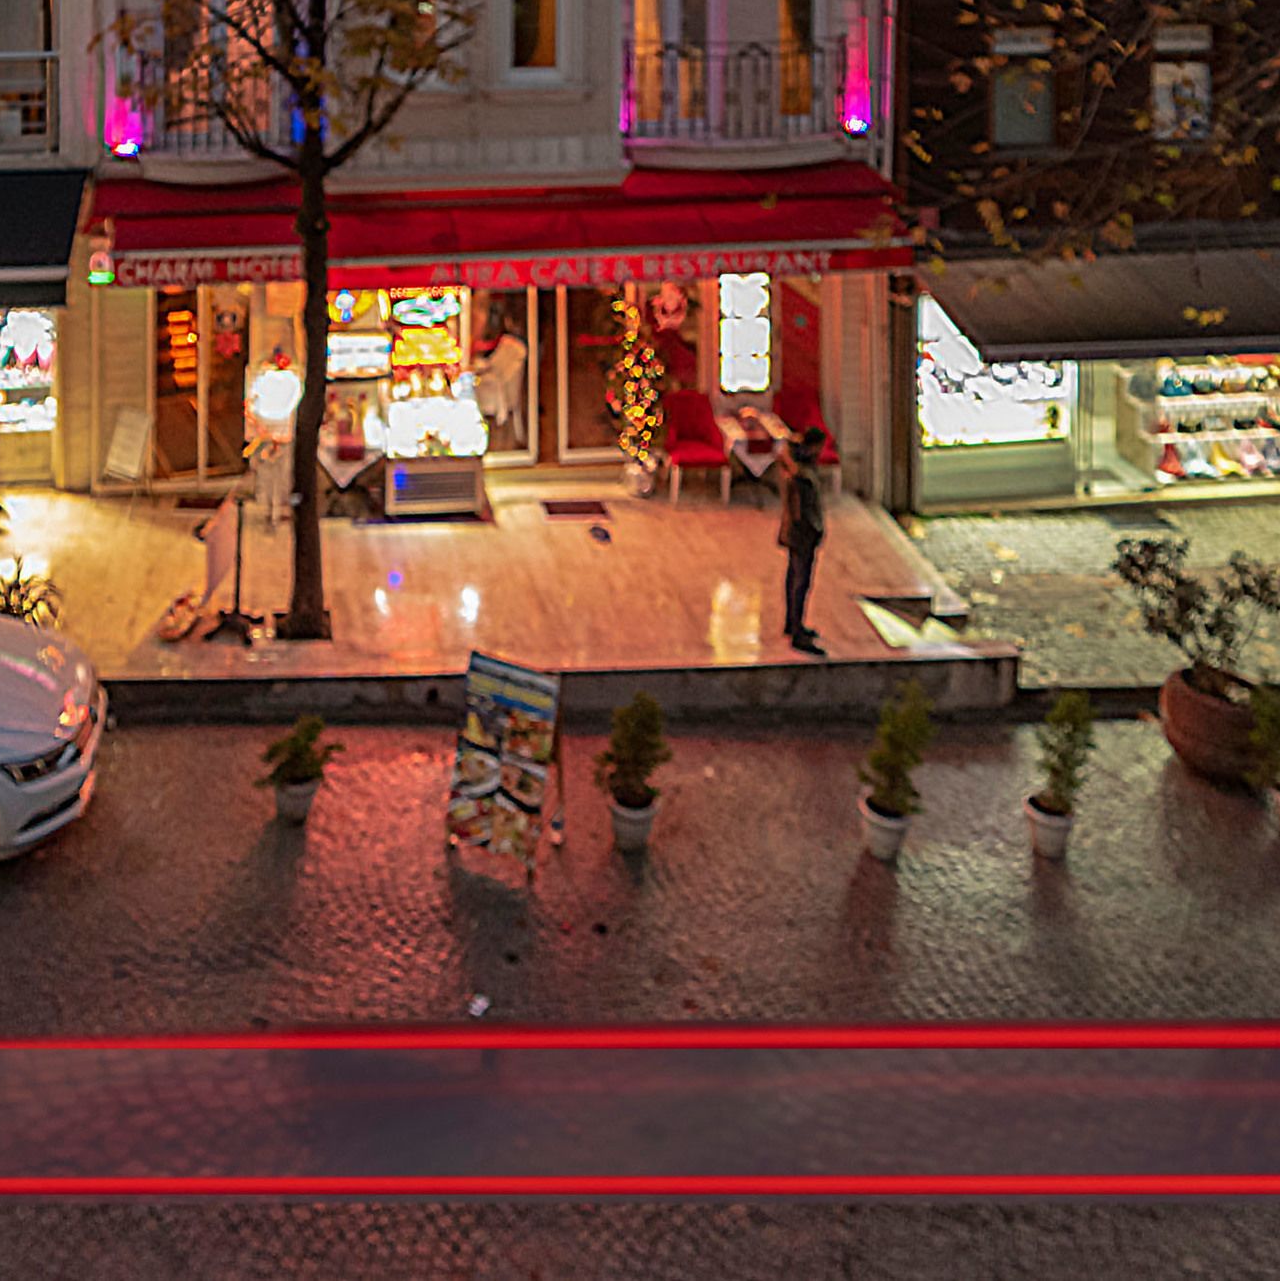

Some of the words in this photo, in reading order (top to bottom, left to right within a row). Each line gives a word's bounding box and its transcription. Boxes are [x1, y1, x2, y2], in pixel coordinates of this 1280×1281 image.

[118, 258, 216, 286] CHARM
[431, 264, 520, 287] AURA
[641, 251, 831, 278] RESTAURANT
